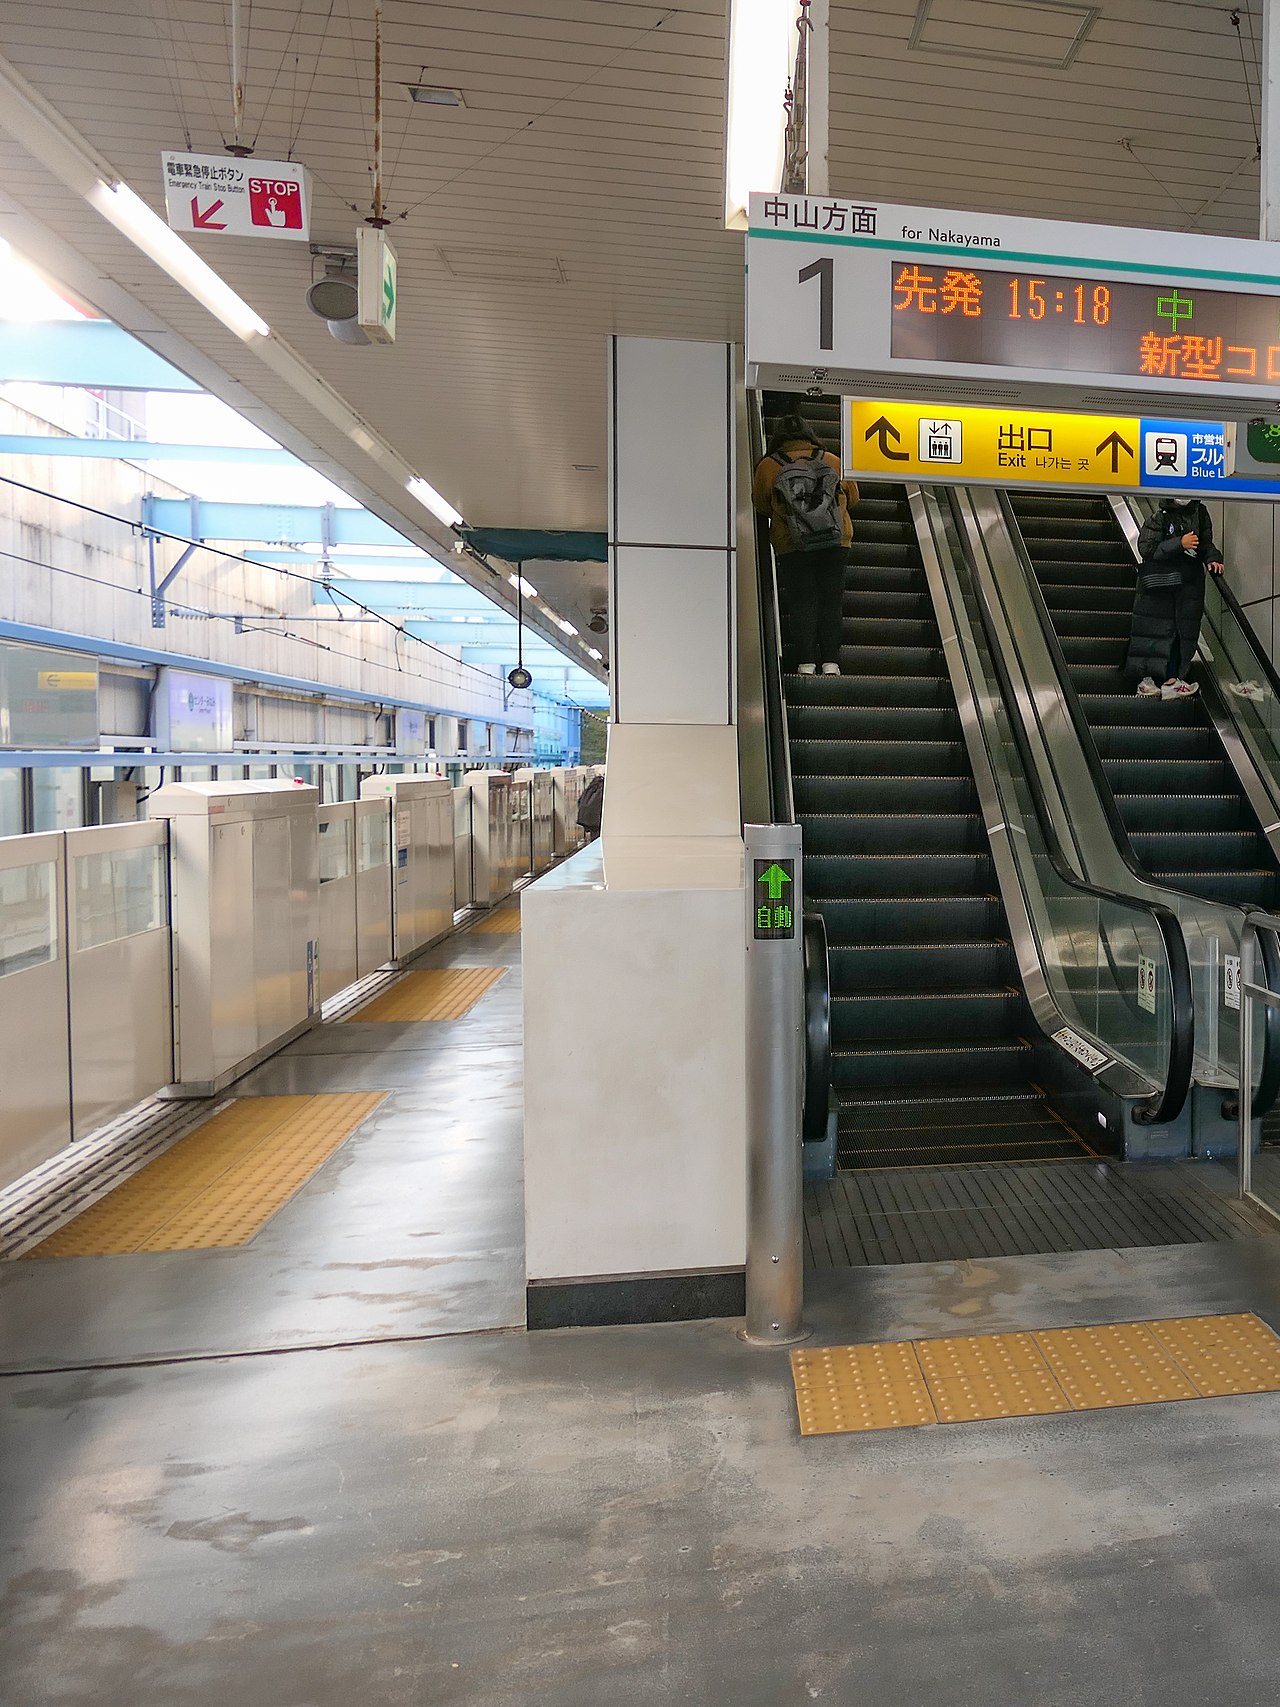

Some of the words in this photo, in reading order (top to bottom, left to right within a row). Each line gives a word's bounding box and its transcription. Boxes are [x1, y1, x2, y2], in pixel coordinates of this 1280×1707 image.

[167, 162, 244, 182] 電車緊急停止ボタン
[168, 178, 197, 190] Emergency
[200, 181, 212, 191] Train
[213, 182, 227, 193] Stop
[227, 183, 245, 194] Button
[250, 179, 298, 196] STOP
[764, 196, 878, 236] 中山方面
[901, 226, 922, 240] for
[928, 228, 1001, 248] Nakayama
[798, 257, 834, 351] 1
[894, 266, 983, 317] 先発
[1009, 278, 1111, 326] 15:18
[1156, 289, 1193, 332] 中
[998, 424, 1052, 452] 出口
[998, 452, 1027, 468] Exit
[1035, 456, 1072, 470] 나가는
[1077, 458, 1090, 471] 곳
[1191, 466, 1216, 478] Blue
[757, 905, 792, 928] 自動
